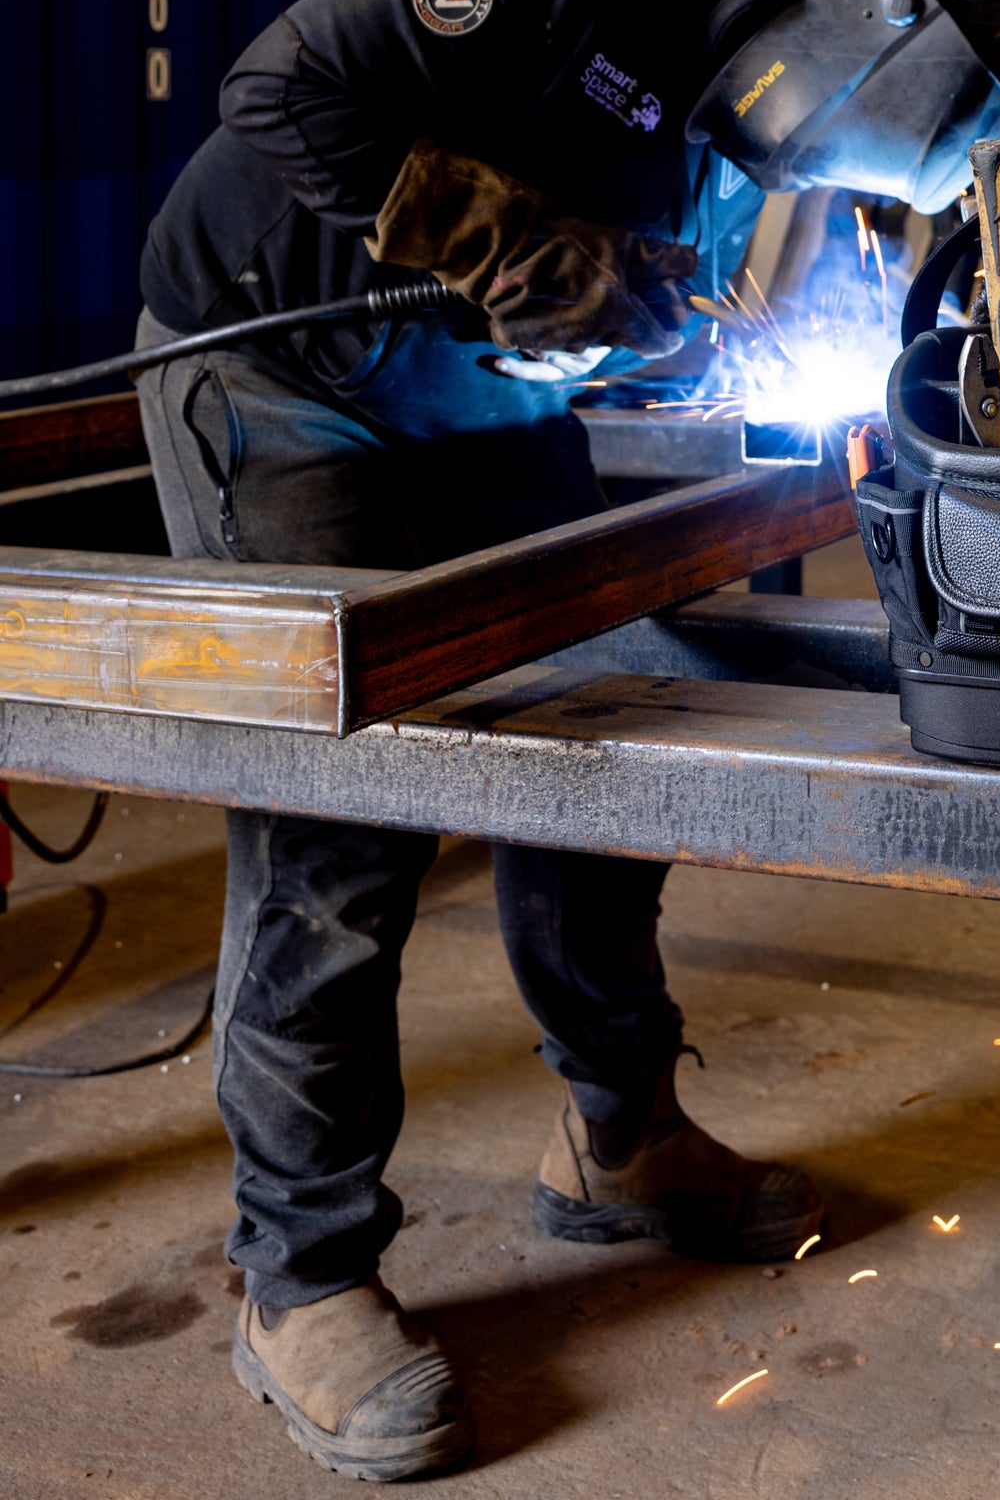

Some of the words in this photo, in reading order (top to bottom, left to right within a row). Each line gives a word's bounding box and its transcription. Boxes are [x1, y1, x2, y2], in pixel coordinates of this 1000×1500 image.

[580, 67, 627, 107] Space
[590, 53, 637, 93] Smart
[734, 60, 785, 117] SAVAGE
